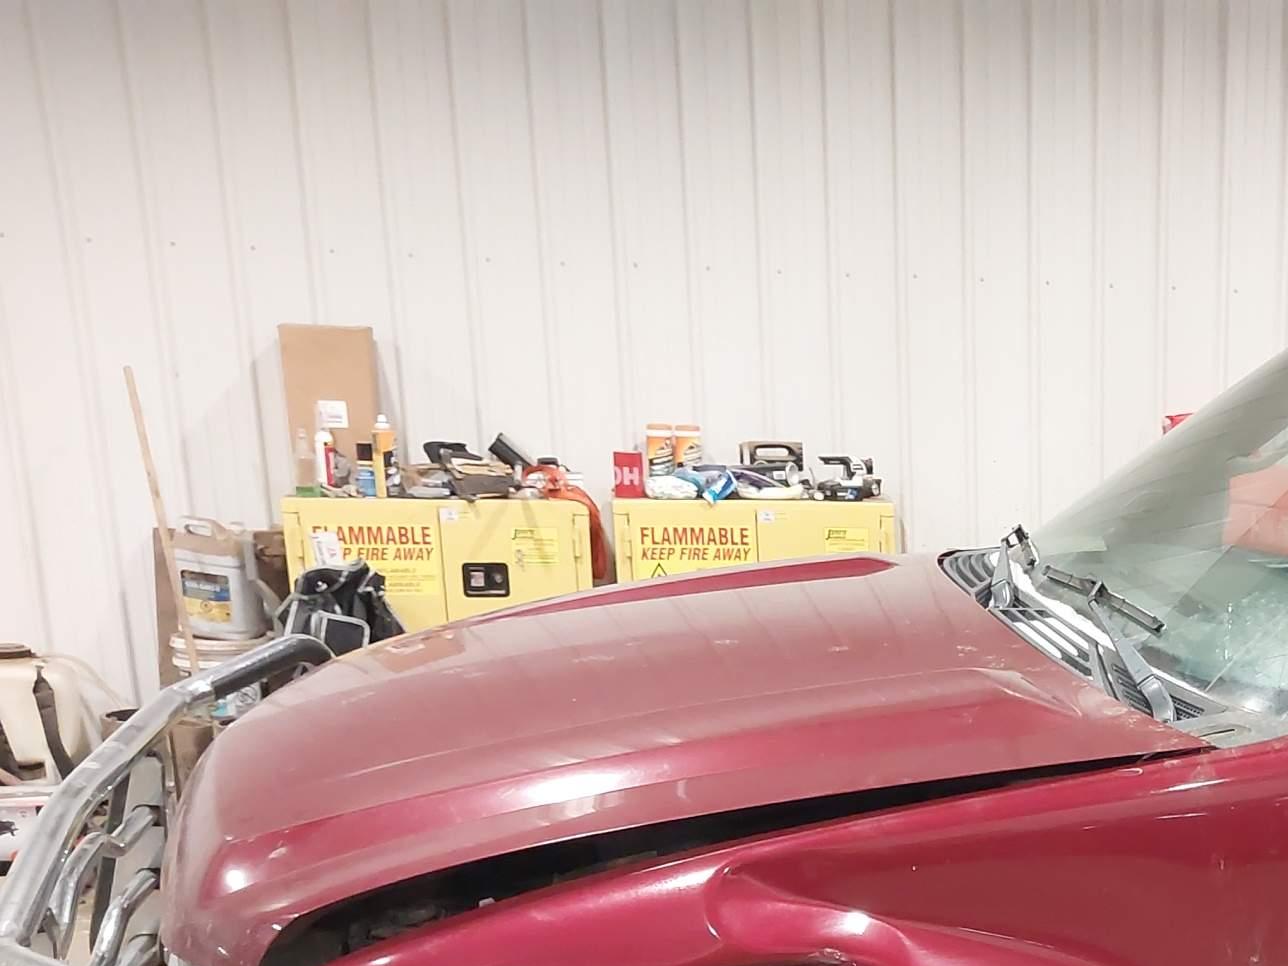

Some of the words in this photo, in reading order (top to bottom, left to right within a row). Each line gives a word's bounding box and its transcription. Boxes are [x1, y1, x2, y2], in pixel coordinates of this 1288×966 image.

[640, 527, 749, 546] FLAMMABLE
[357, 547, 389, 561] FIRE
[393, 547, 434, 561] AWAY
[641, 547, 675, 561] KEEP
[680, 547, 709, 561] FIRE
[713, 547, 751, 561] AWAY
